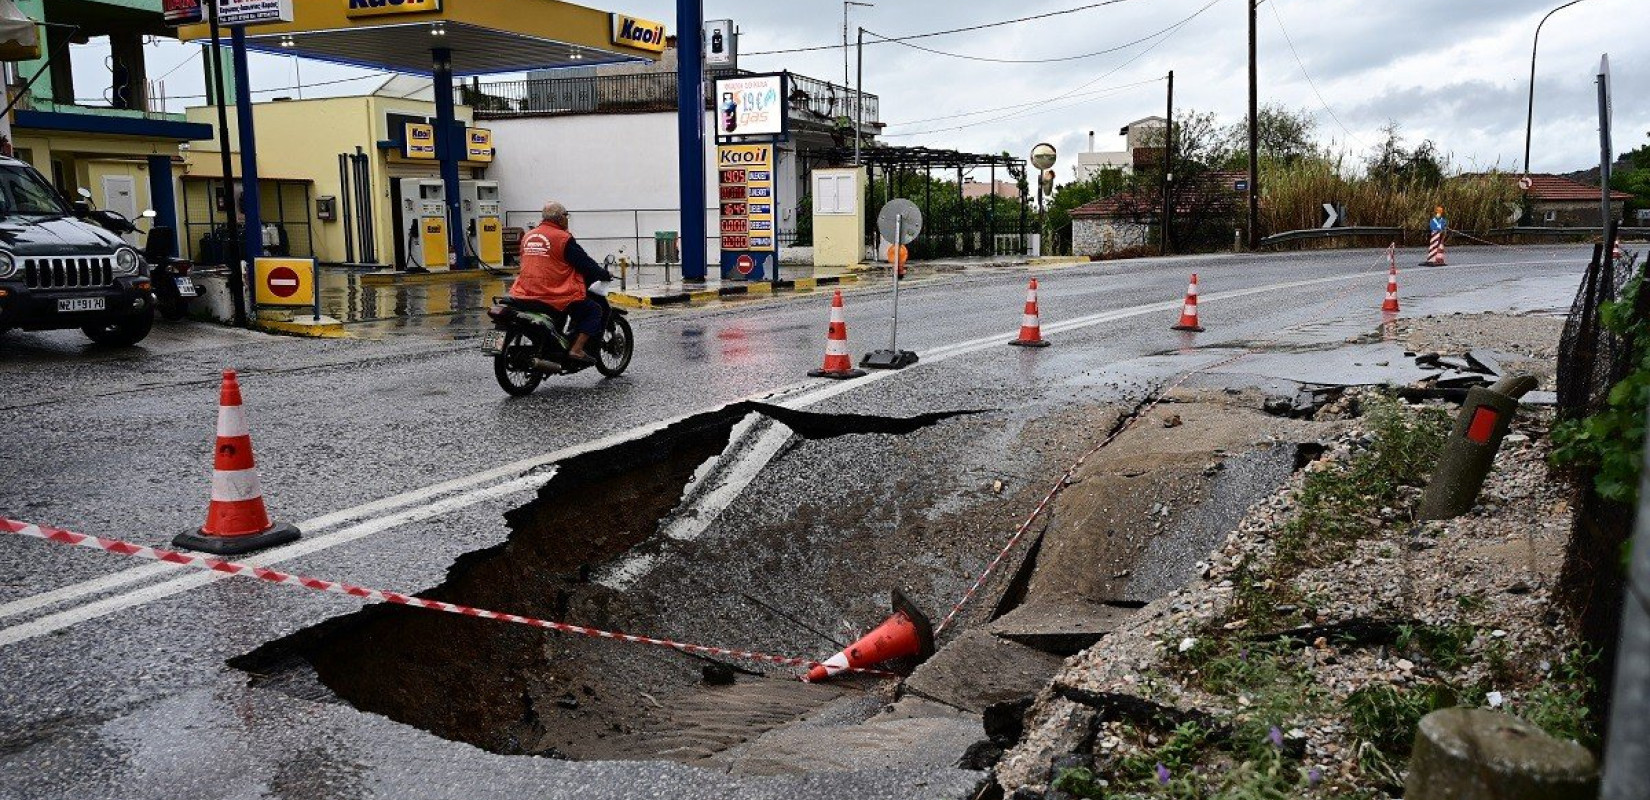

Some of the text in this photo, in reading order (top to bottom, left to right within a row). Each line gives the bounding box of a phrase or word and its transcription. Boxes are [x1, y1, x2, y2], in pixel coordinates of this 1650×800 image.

[620, 18, 664, 45] Kaoil
[741, 112, 768, 126] gas
[721, 147, 767, 163] Kaoil
